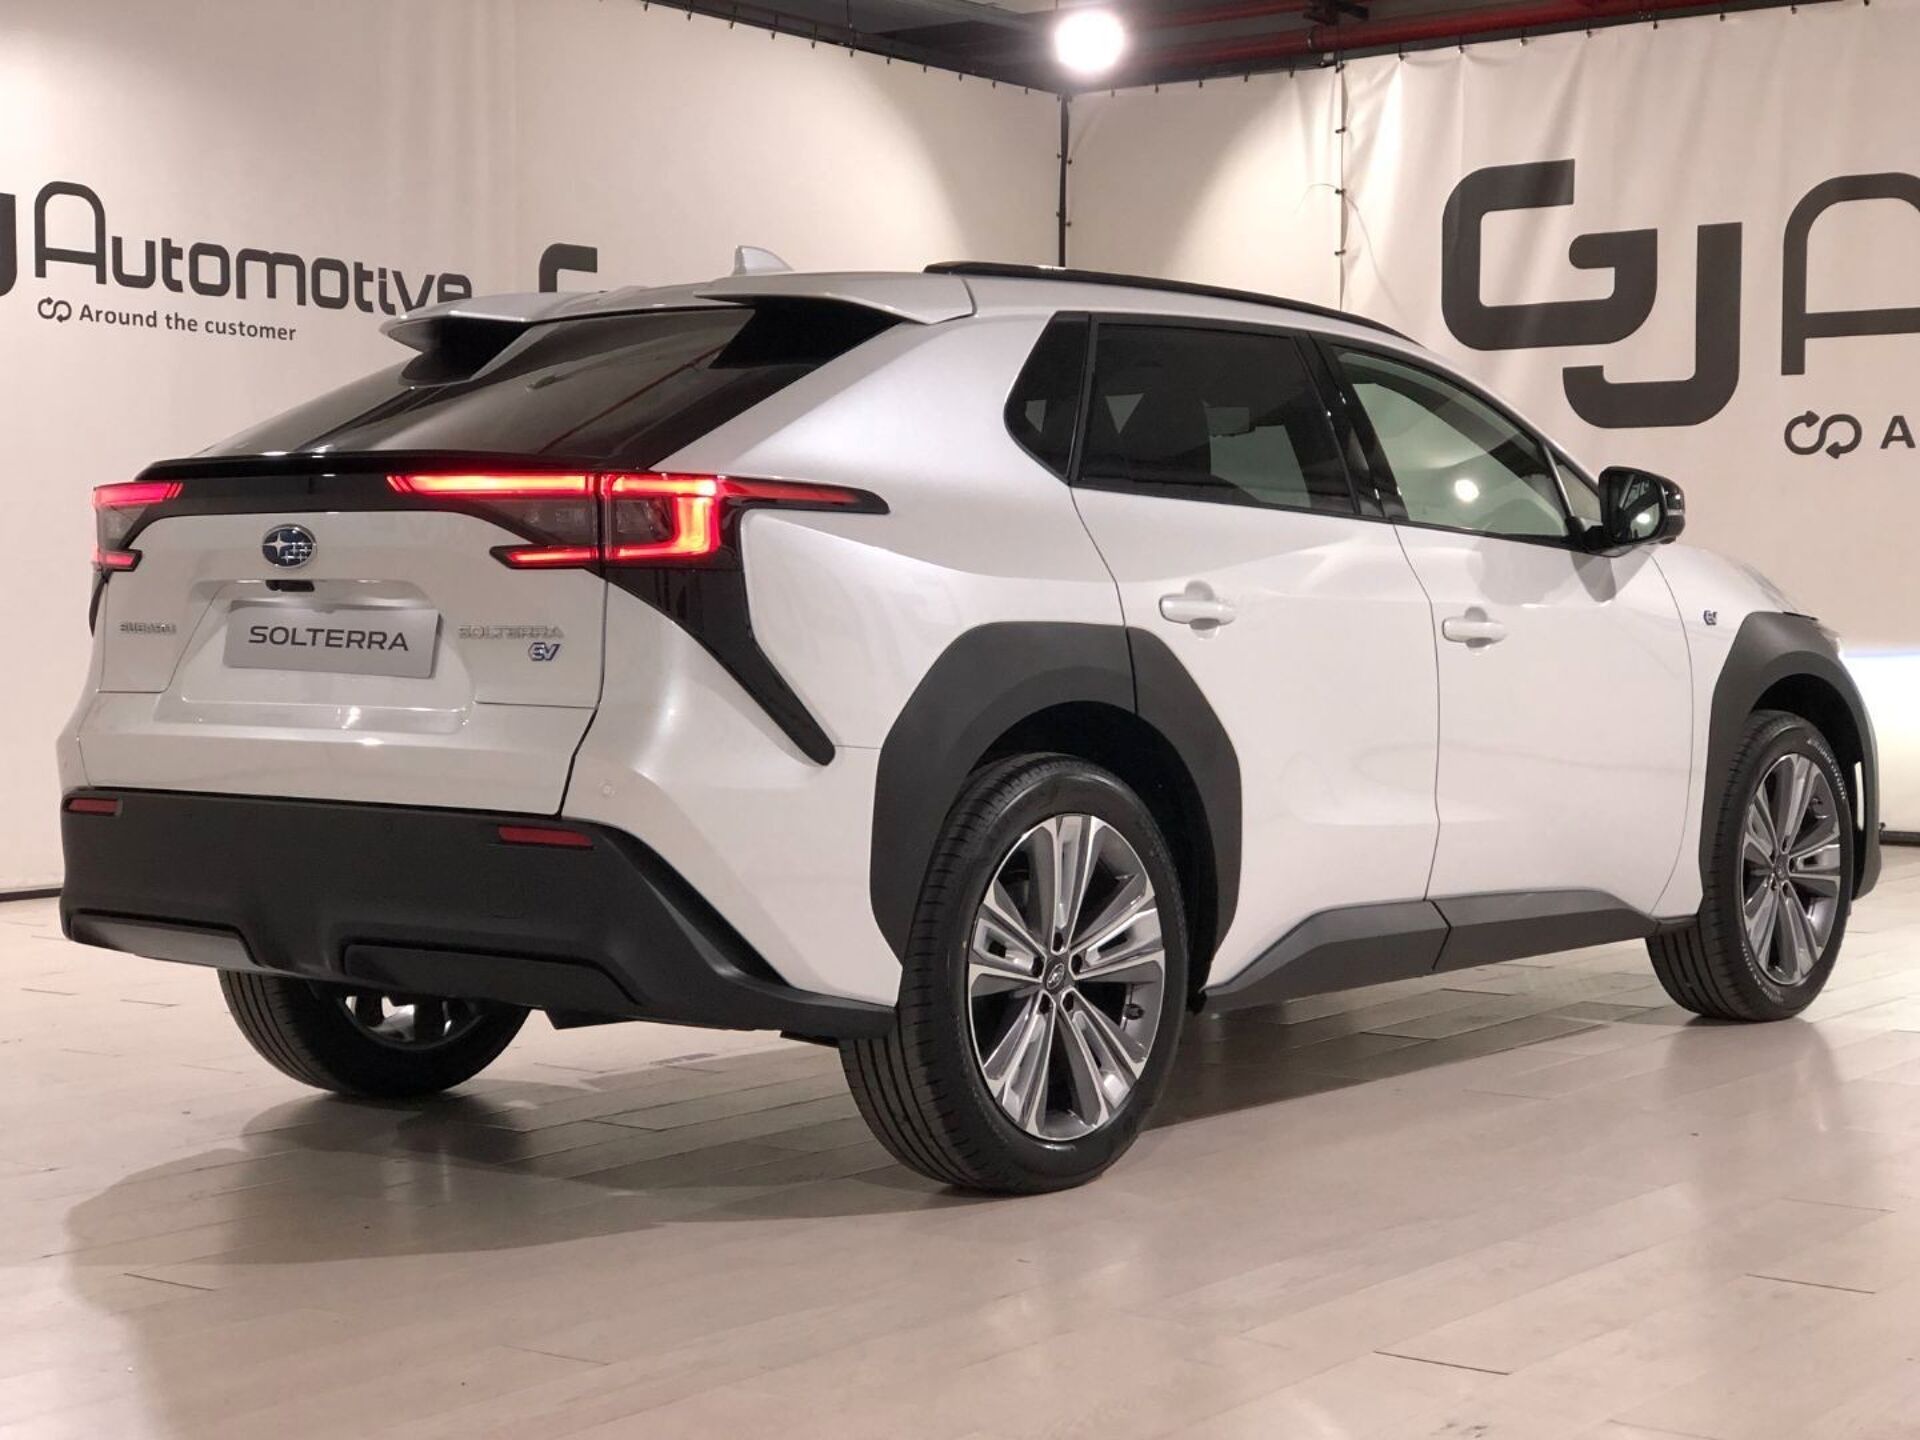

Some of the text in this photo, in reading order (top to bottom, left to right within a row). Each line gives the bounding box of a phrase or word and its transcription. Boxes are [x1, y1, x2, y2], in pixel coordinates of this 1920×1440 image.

[79, 303, 297, 341] Around the customer
[248, 625, 409, 652] SOLTERRA
